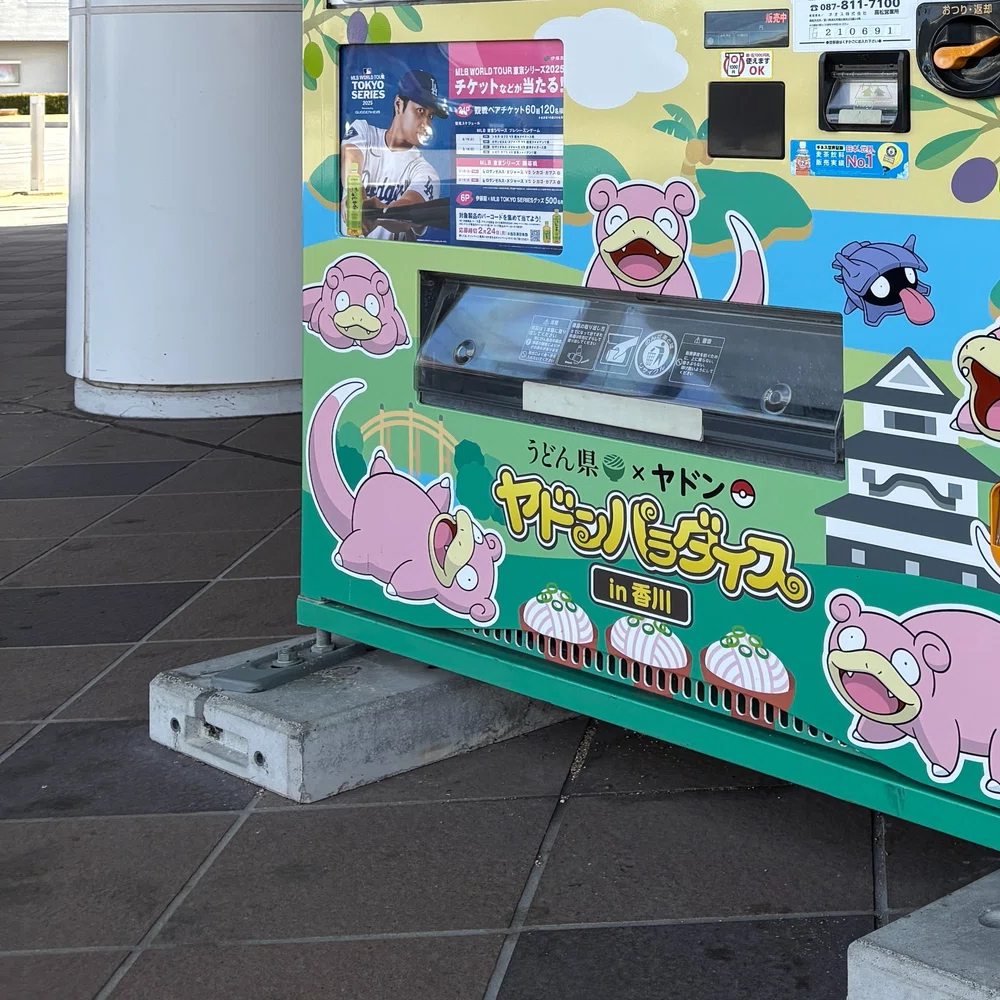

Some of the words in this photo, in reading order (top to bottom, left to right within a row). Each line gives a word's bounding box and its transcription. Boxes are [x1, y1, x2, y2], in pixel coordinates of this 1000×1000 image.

[942, 4, 992, 15] おつり・返却
[765, 12, 787, 23] 販売中
[455, 68, 468, 76] MLB
[470, 67, 492, 75] WORLD
[494, 67, 512, 75] TOUR
[749, 66, 765, 75] OK
[352, 80, 384, 90] TOKYO
[455, 77, 563, 95] チケットなどが当たる!
[351, 89, 385, 100] SERIES
[846, 154, 873, 168] No.1
[461, 194, 470, 202] 6P
[527, 439, 599, 478] うどん県
[651, 463, 725, 499] ヤドン
[494, 466, 807, 603] ヤドンパラダイス
[609, 577, 627, 602] in
[631, 583, 671, 615] 香川
